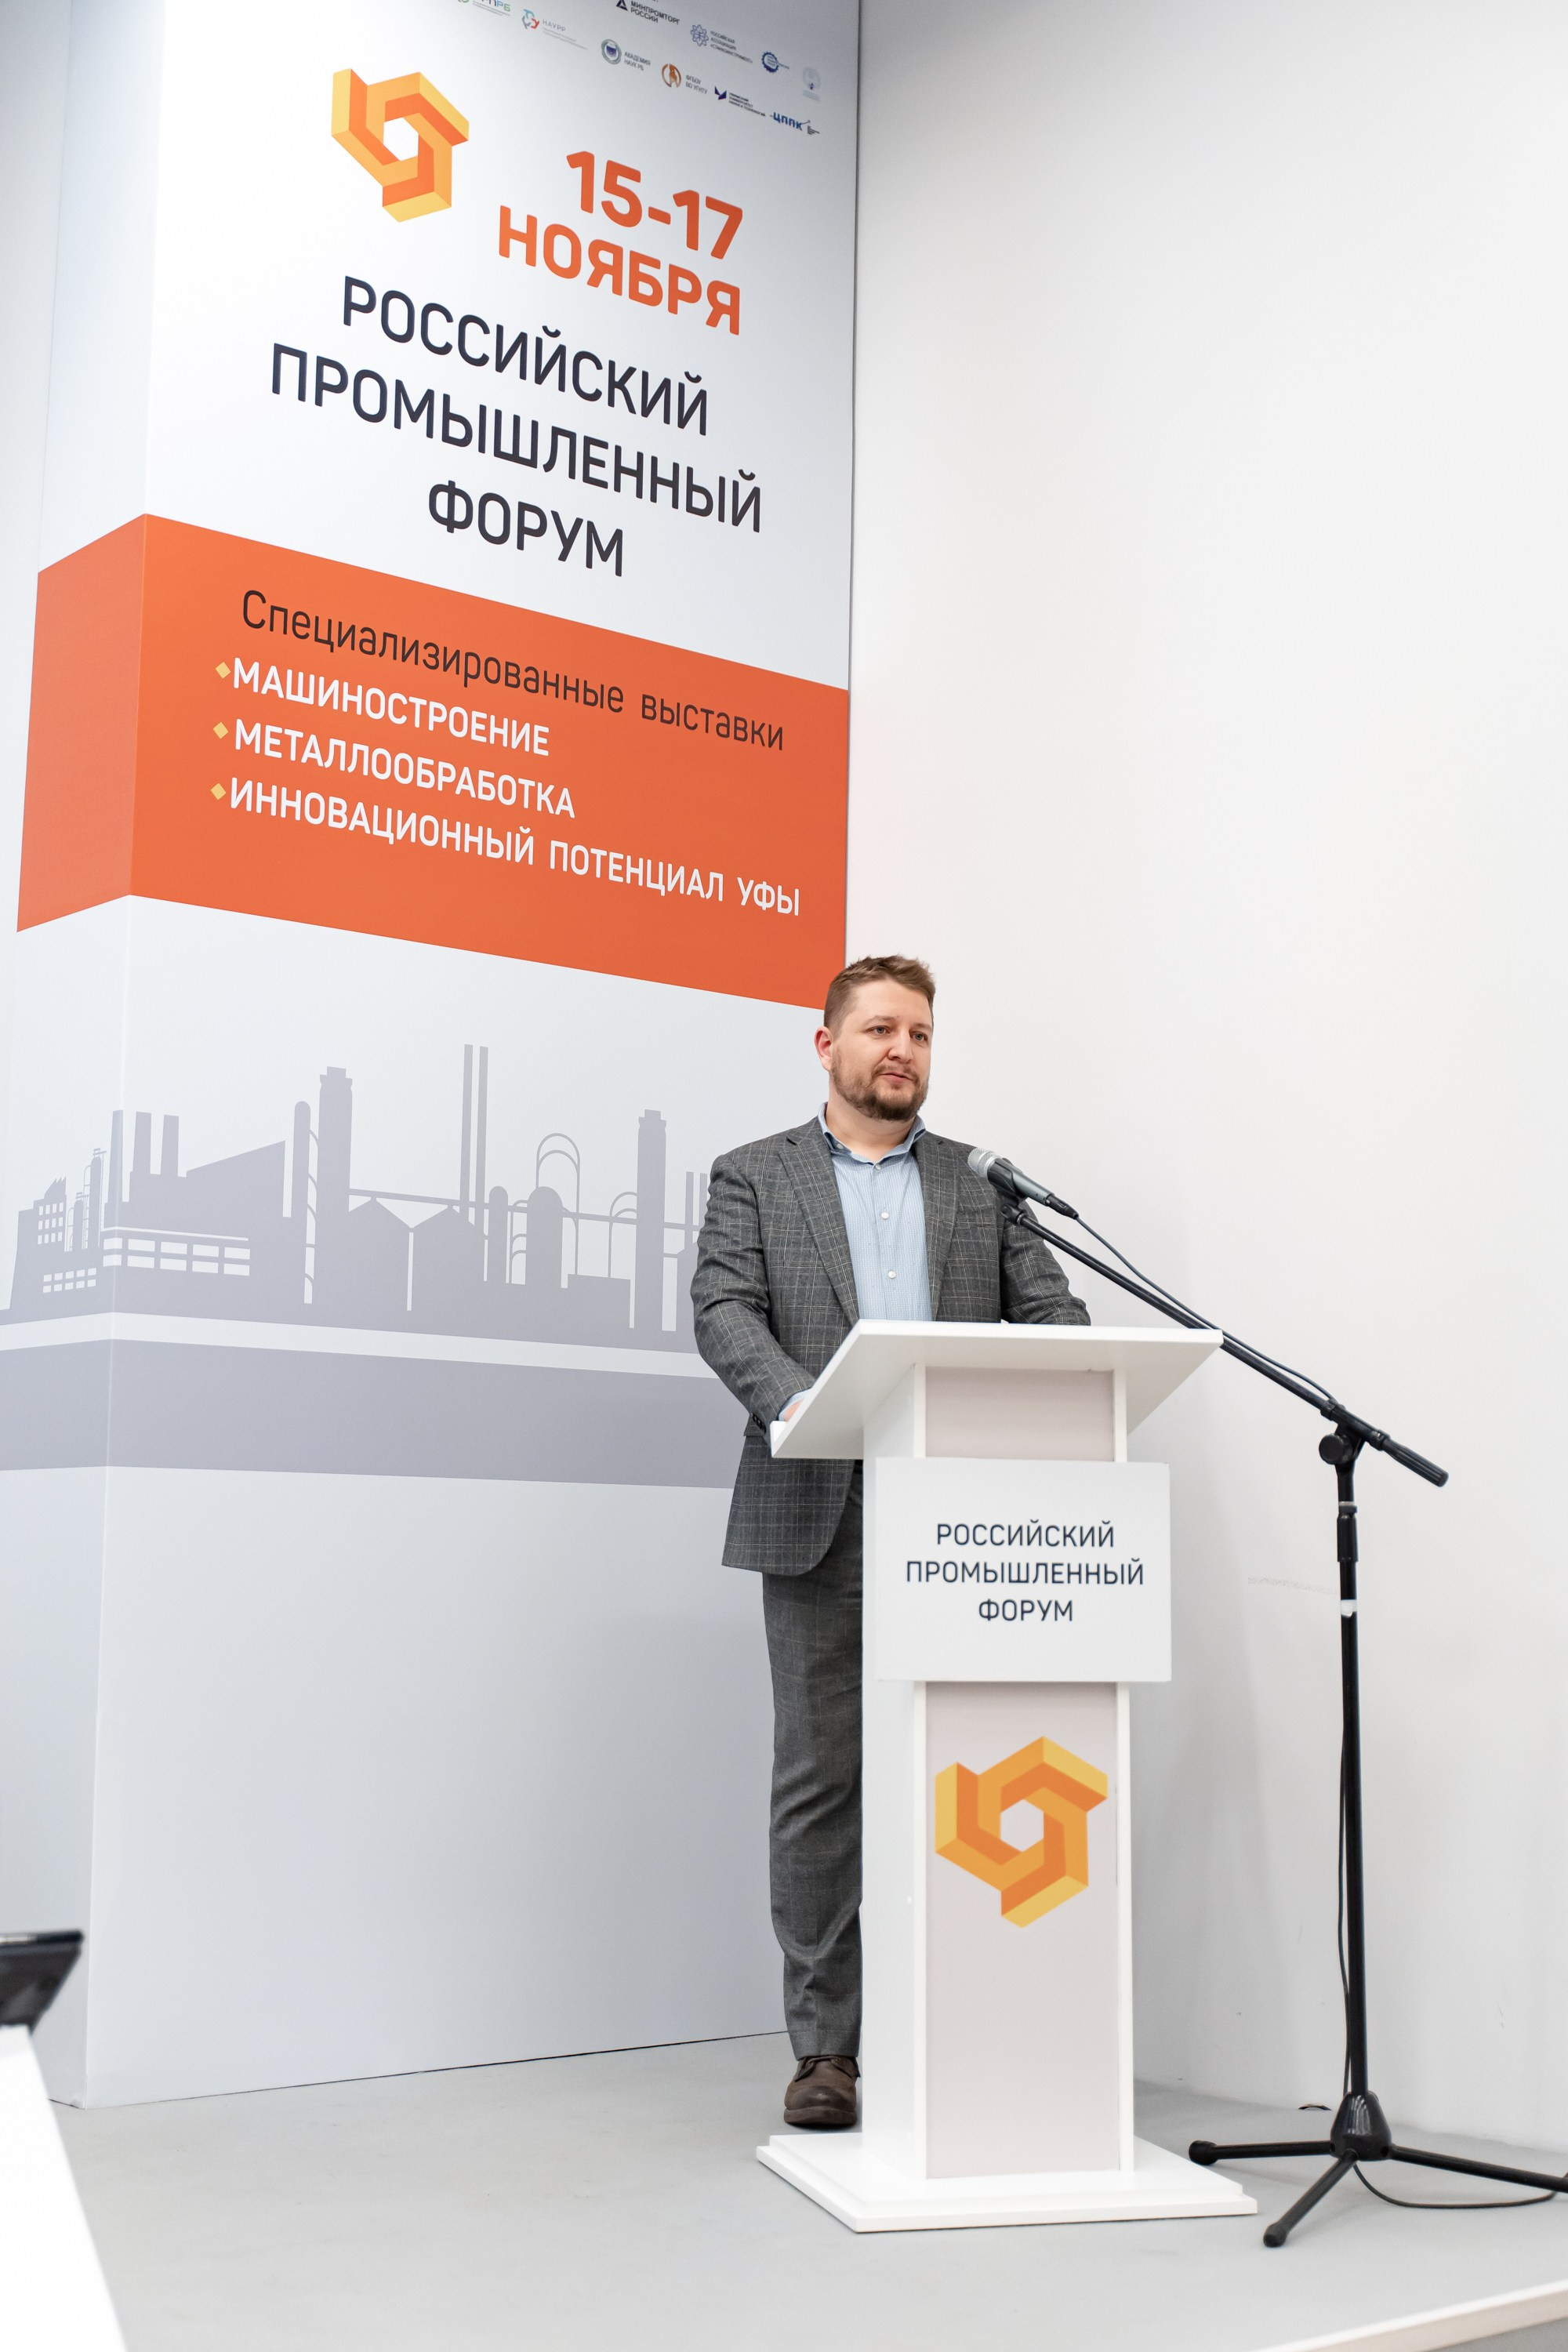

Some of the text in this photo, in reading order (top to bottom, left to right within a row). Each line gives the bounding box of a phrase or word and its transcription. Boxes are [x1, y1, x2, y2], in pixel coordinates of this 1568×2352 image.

[542, 19, 566, 31] НАУРР
[630, 1, 680, 24] МИНПРОМТОРГ
[630, 7, 659, 23] РОССИИ
[624, 51, 651, 66] АКАДЕМИЯ
[624, 59, 637, 68] НАУК
[773, 111, 802, 131] ЦППК
[566, 151, 743, 260] 15-17
[498, 205, 741, 336] НОЯБРЯ
[343, 275, 708, 437] РОССИЙСКИЙ
[272, 343, 761, 534] ПРОМЫШЛЕННЫЙ
[429, 480, 624, 578] ФОРУМ
[242, 590, 783, 751] Специализированные выставки
[233, 657, 550, 757] МАШИНОСТРОЕНИЕ
[235, 718, 575, 818] МЕТАЛЛООБРАБОТКА
[230, 777, 800, 916] ИННОВАЦИОННЫЙ ПОТЕНЦИАЛ УФЫ
[937, 1519, 1114, 1548] РОССИЙСКИЙ
[906, 1558, 1143, 1585] ПРОМЫШЛЕННЫЙ
[978, 1599, 1073, 1621] ФОРУМ
